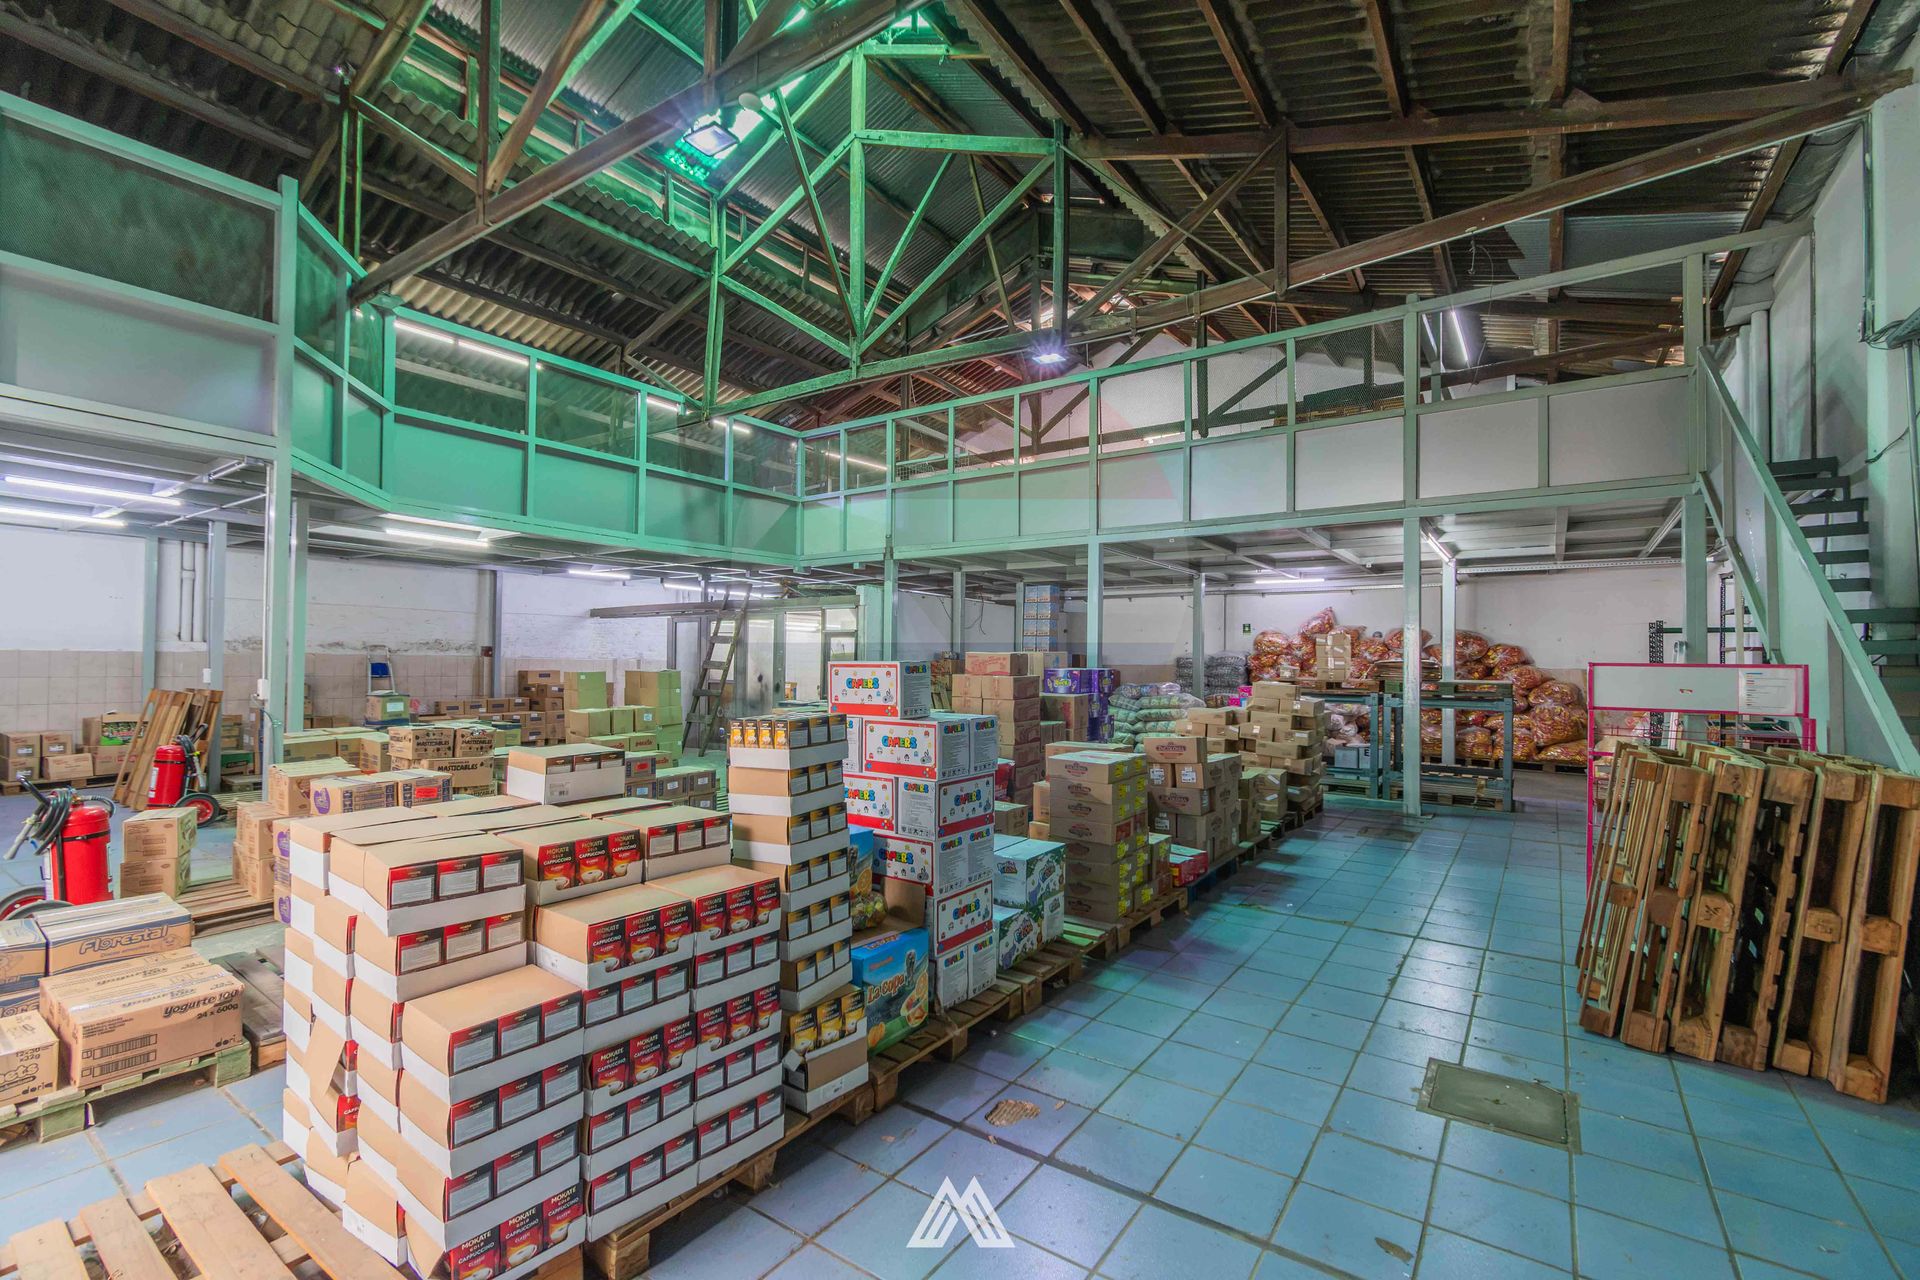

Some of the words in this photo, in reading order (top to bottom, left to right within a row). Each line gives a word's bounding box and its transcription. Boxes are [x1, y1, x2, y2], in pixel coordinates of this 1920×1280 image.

[846, 677, 879, 689] GAMERS
[882, 735, 917, 749] GAMERS
[438, 764, 478, 772] MASTICABLES
[954, 789, 982, 807] GAMERS
[879, 848, 913, 865] GAMERS
[632, 914, 655, 926] MOKATE
[663, 916, 689, 927] CAPPUCCINO
[595, 923, 620, 935] MOKATE
[629, 925, 657, 937] CAPPUCCINO
[80, 926, 168, 954] Florestal
[592, 934, 622, 947] CAPPUCCINO
[867, 986, 881, 1003] La
[163, 997, 216, 1019] yogurte
[217, 1003, 239, 1014] 600g
[670, 1022, 690, 1034] MOKATE
[215, 1034, 236, 1048] dori
[636, 1034, 659, 1047] MOKATE
[667, 1030, 693, 1044] CAPPUCCINO
[600, 1048, 625, 1061] MOKATE
[633, 1043, 661, 1058] CAPPUCCINO
[597, 1058, 626, 1072] CAPPUCCINO
[551, 1187, 577, 1204] MOKATE
[548, 1197, 578, 1217] CAPPUCCINO
[508, 1208, 537, 1226] MOKATE
[505, 1218, 539, 1240] CAPPUCCINO
[461, 1231, 492, 1251] MOKATE
[458, 1242, 495, 1264] CAPPUCCINO
